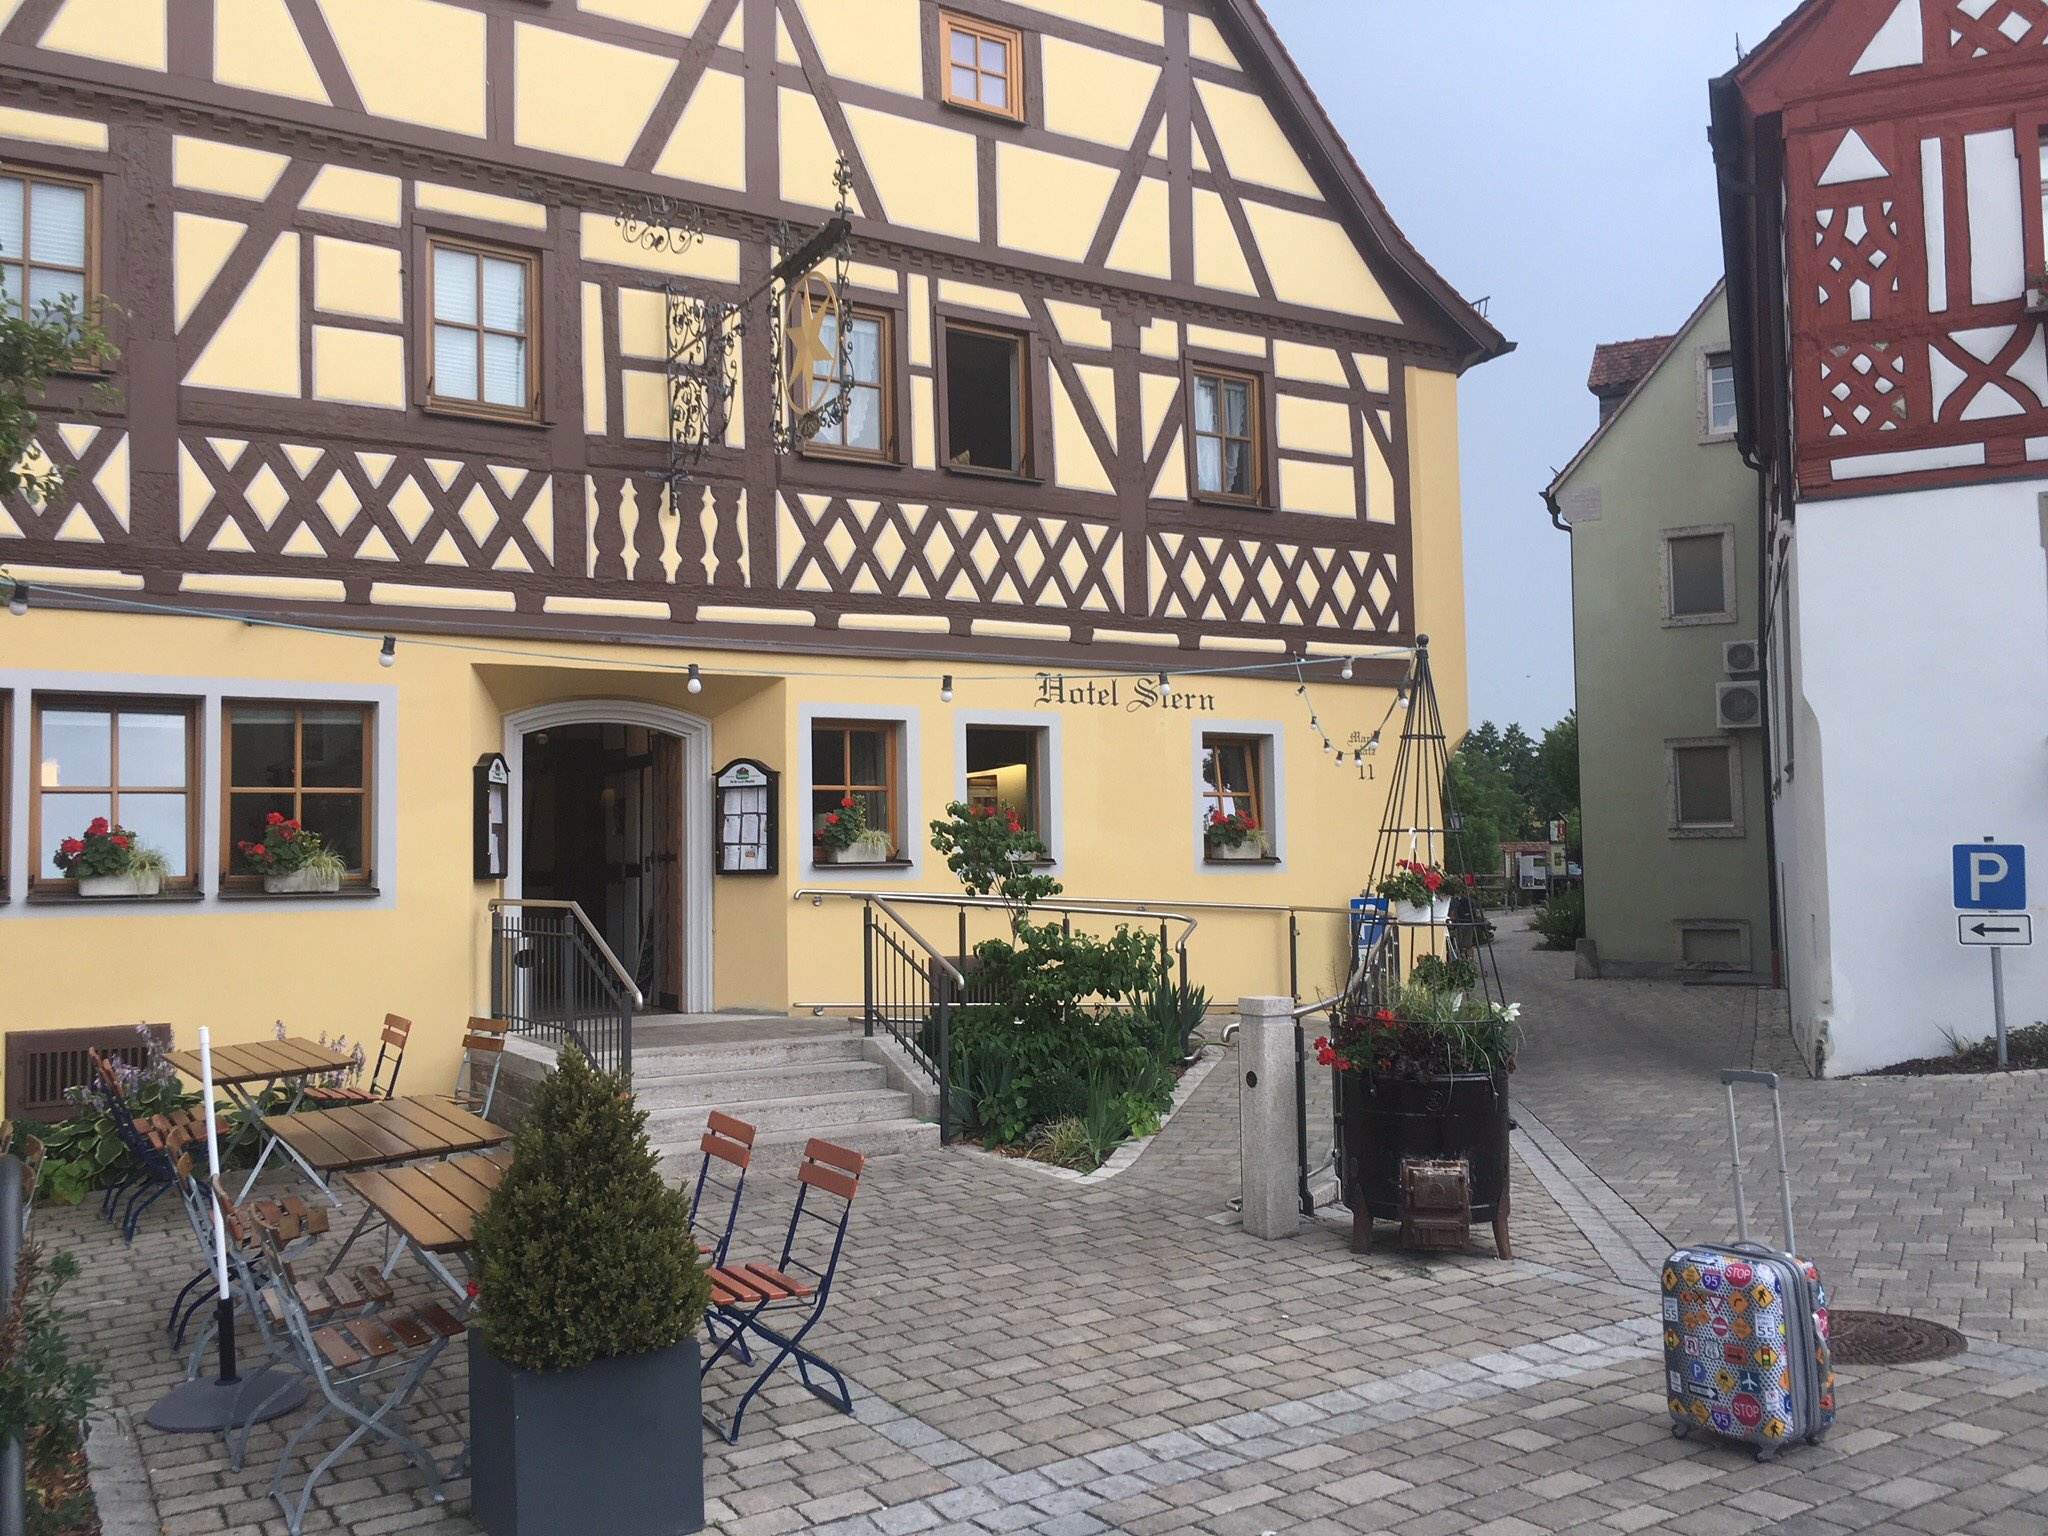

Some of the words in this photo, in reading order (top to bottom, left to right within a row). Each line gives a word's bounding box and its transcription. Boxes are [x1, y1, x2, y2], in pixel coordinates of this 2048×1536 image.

[1034, 671, 1120, 708] Hotel
[1358, 763, 1376, 780] 11
[1970, 852, 2008, 901] P
[1725, 1266, 1751, 1280] STOP
[1704, 1275, 1718, 1287] 95
[1665, 1308, 1678, 1320] 55
[1757, 1325, 1774, 1336] 55
[1693, 1363, 1702, 1378] P
[1733, 1402, 1760, 1418] STOP
[1714, 1412, 1729, 1425] 95
